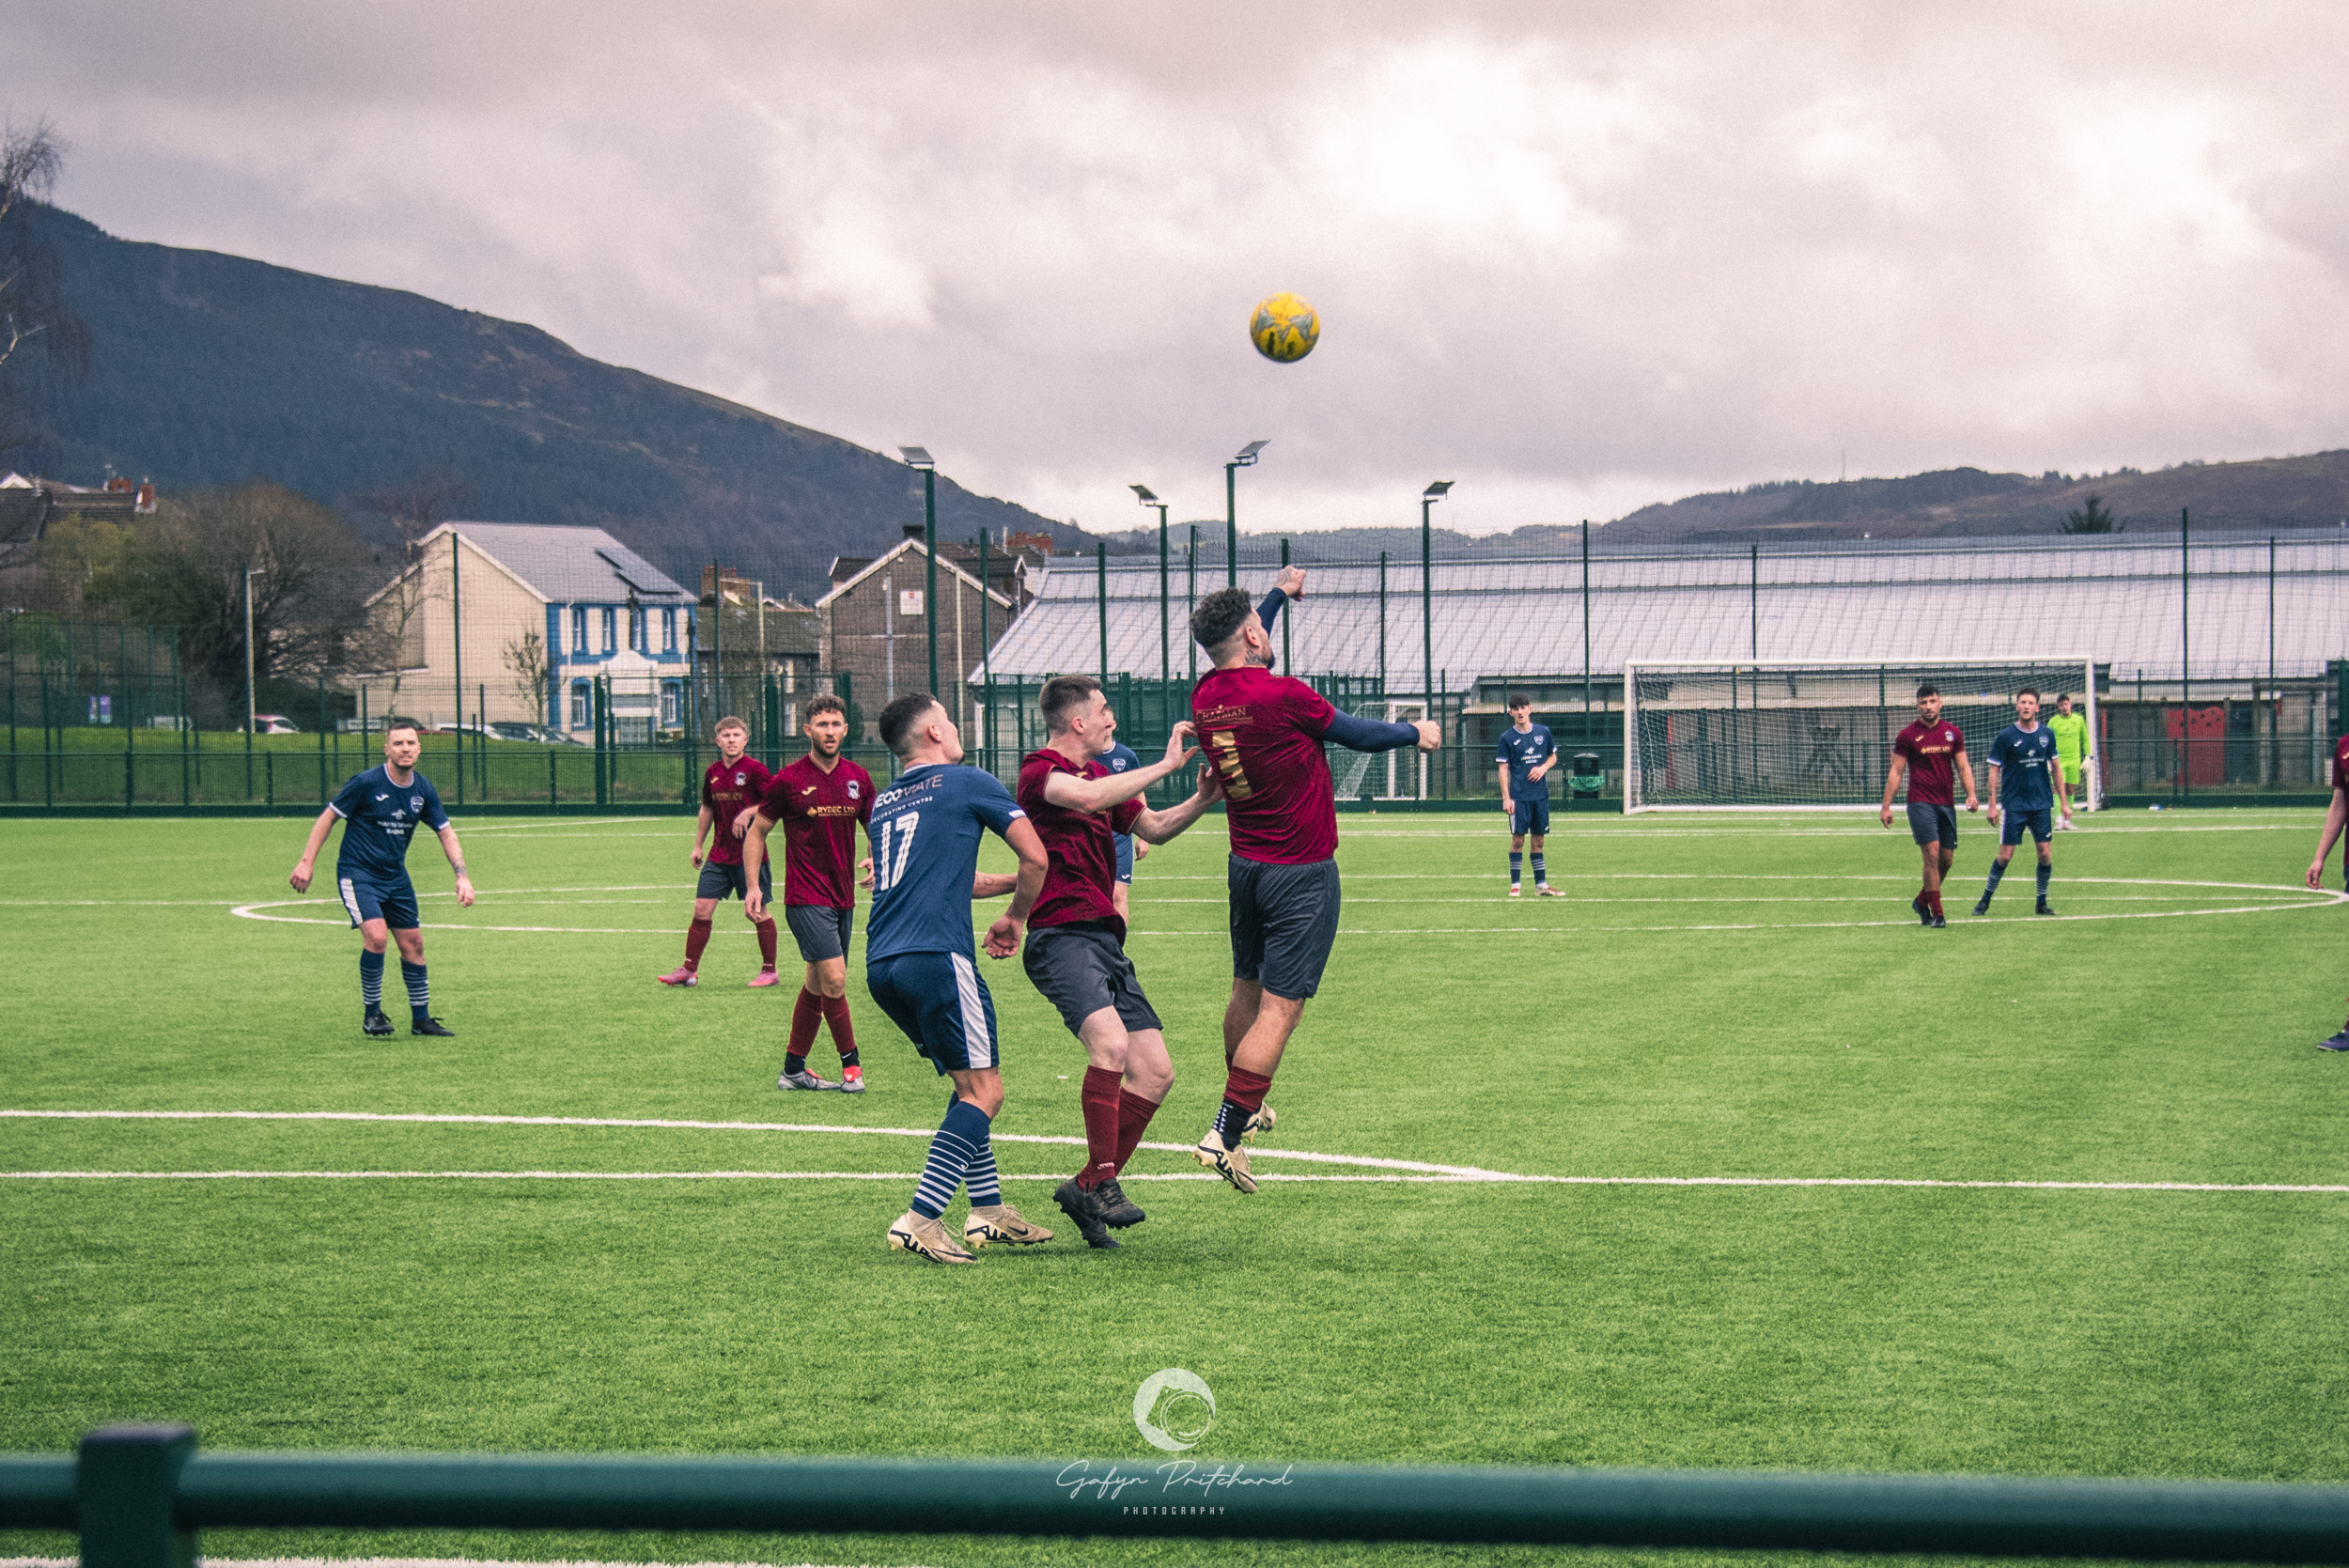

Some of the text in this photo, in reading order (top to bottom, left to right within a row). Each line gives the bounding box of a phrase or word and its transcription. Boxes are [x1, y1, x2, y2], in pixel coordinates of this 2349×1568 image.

[908, 796, 933, 808] CENTRE
[817, 805, 856, 814] RYDEC LTD
[880, 811, 920, 891] 17
